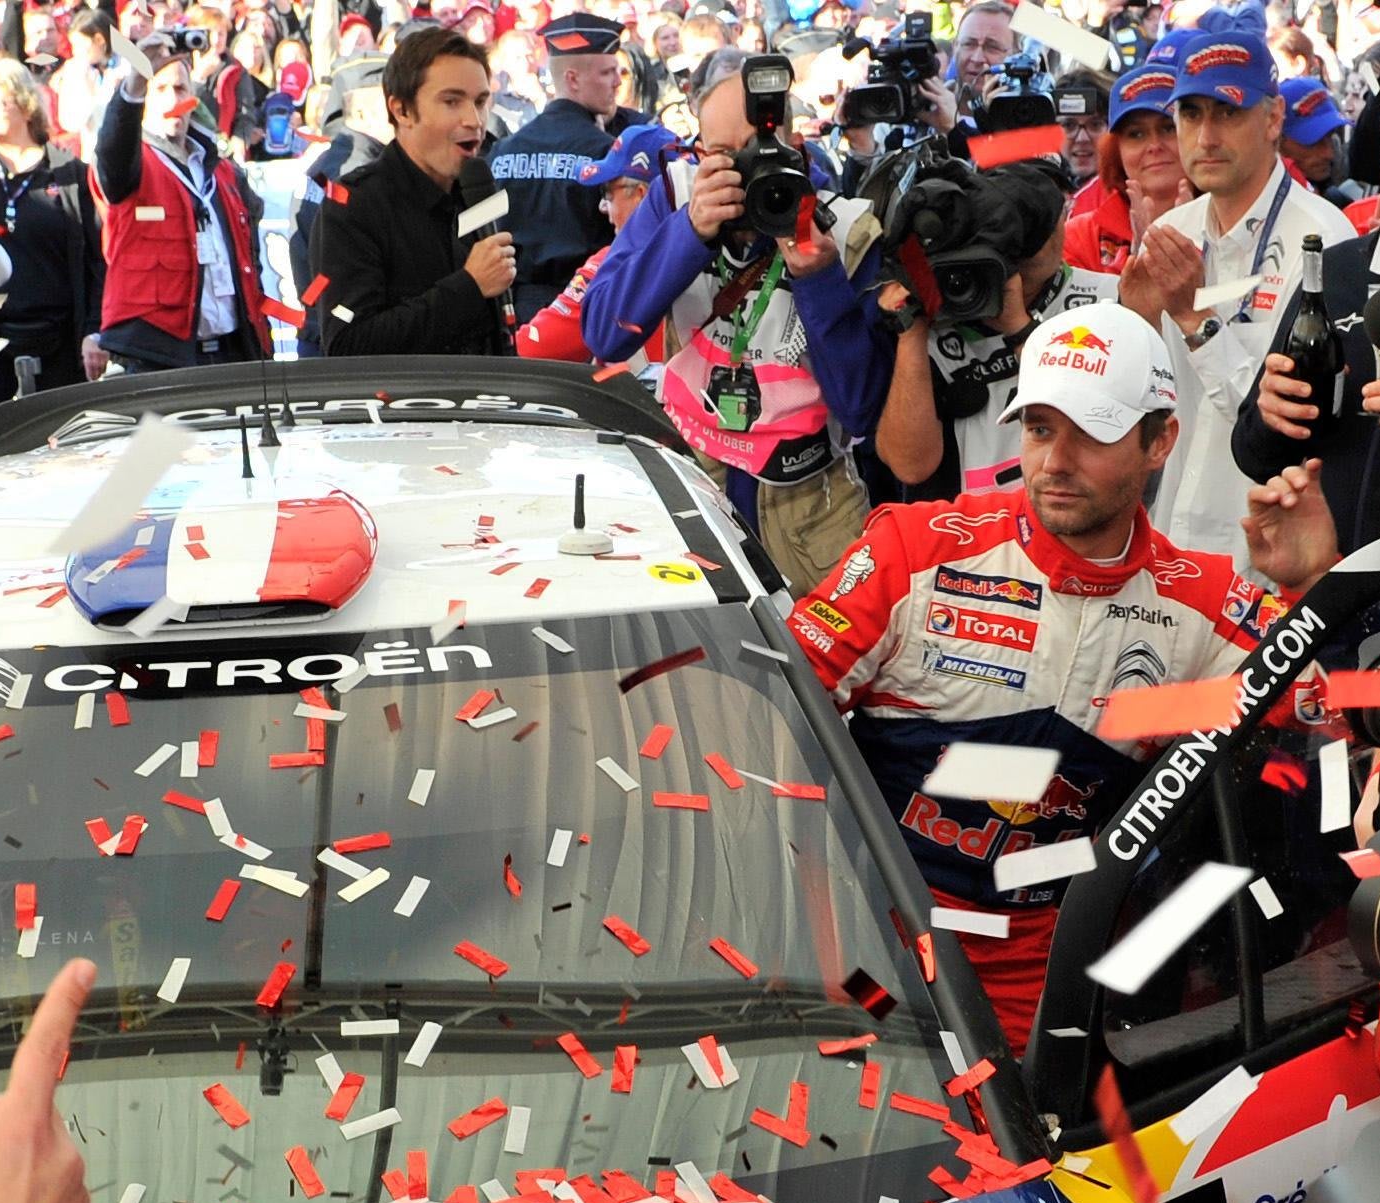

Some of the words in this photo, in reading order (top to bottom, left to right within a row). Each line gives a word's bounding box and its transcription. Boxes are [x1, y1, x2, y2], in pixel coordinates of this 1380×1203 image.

[1038, 351, 1070, 368] Red
[1071, 352, 1107, 377] Bull
[808, 602, 849, 630] Sabelt
[959, 615, 1032, 644] TOTAL
[44, 641, 493, 693] CITROËn
[941, 657, 1024, 685] MICHELIN
[898, 791, 1005, 861] Red
